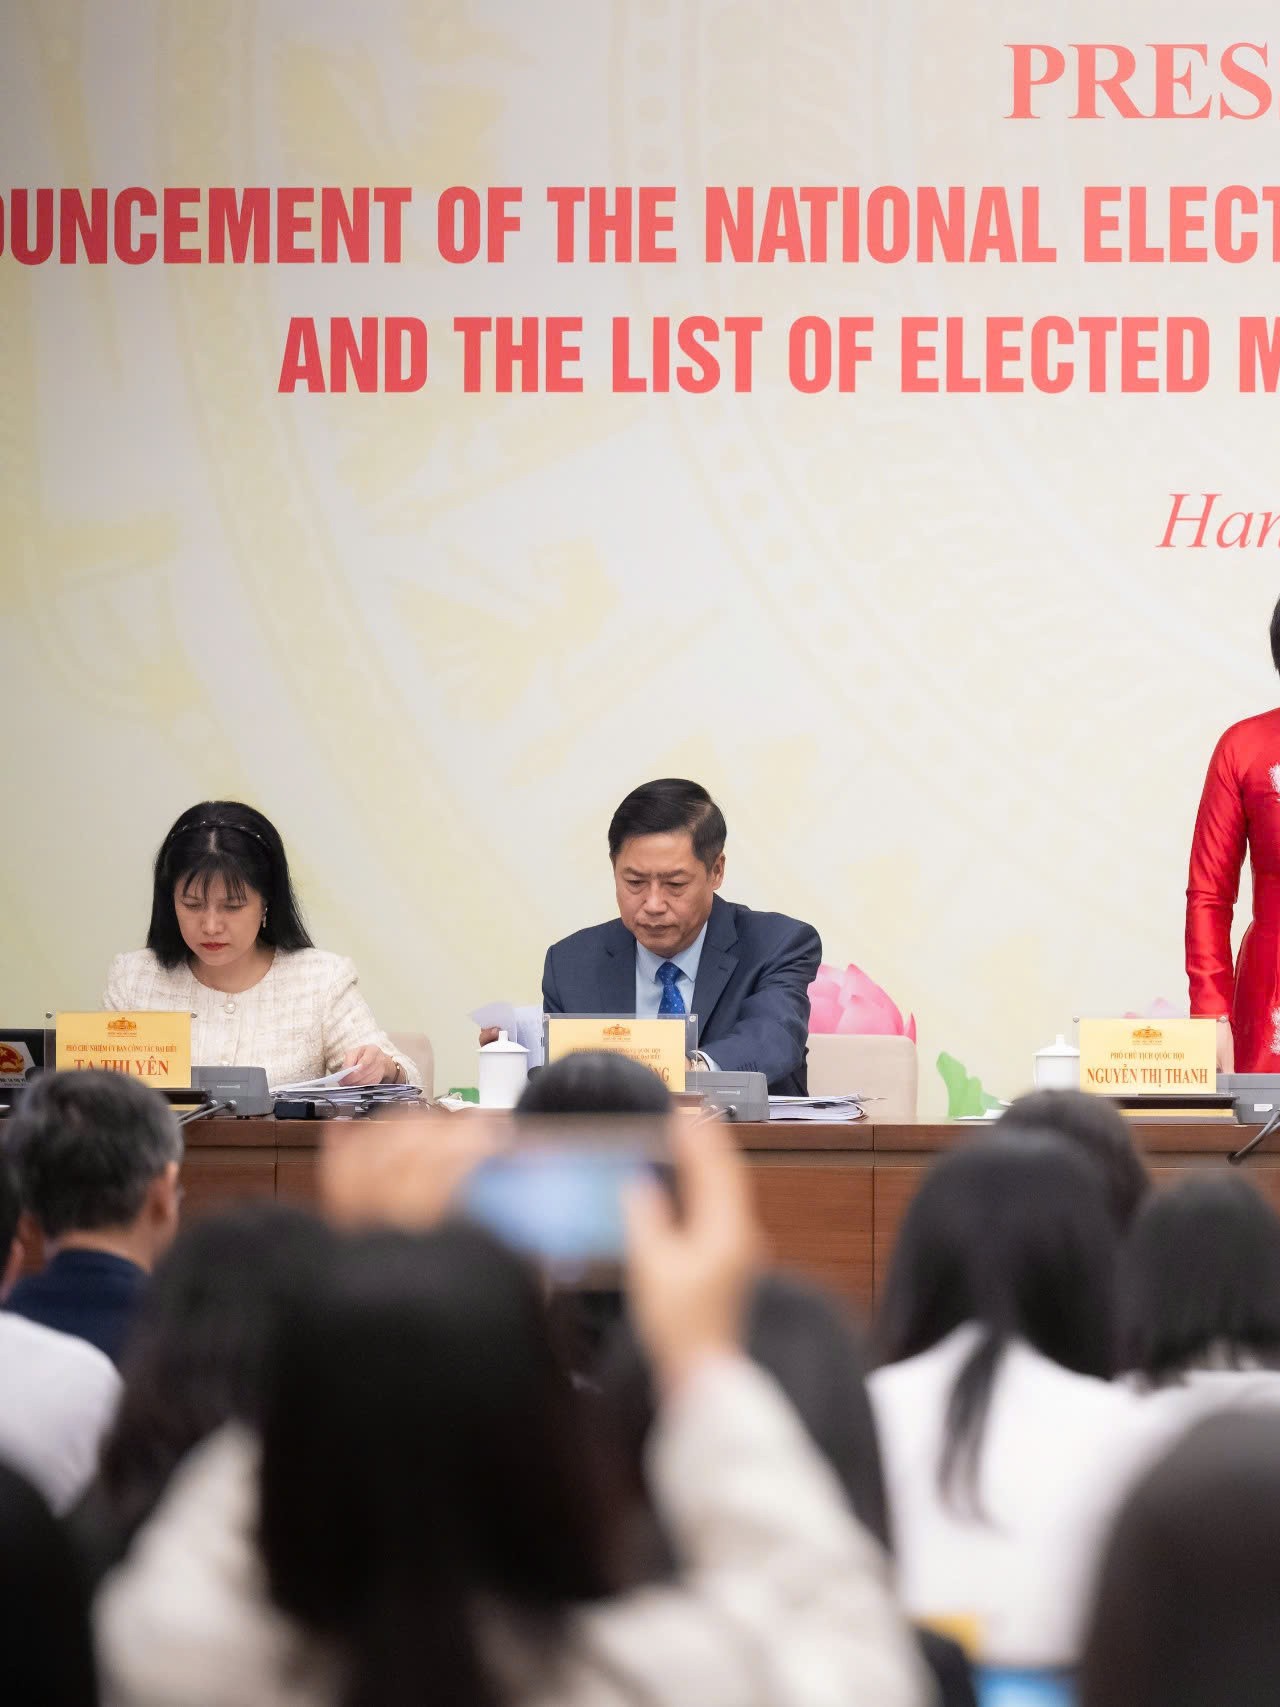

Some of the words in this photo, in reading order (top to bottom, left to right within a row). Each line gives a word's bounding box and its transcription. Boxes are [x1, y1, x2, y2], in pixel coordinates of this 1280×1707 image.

[0, 186, 412, 265] UNCEMENT
[438, 186, 522, 264] OF
[546, 186, 677, 263] THE
[705, 186, 1056, 264] NATIONAL
[278, 316, 428, 393] AND
[453, 316, 583, 393] THE
[612, 315, 763, 394] LIST
[788, 316, 874, 394] OF
[901, 316, 1210, 394] ELECTED
[136, 1056, 168, 1075] YÊN
[1088, 1064, 1137, 1084] NGUYỄN
[1141, 1069, 1161, 1087] THỊ
[1166, 1069, 1208, 1084] THANH
